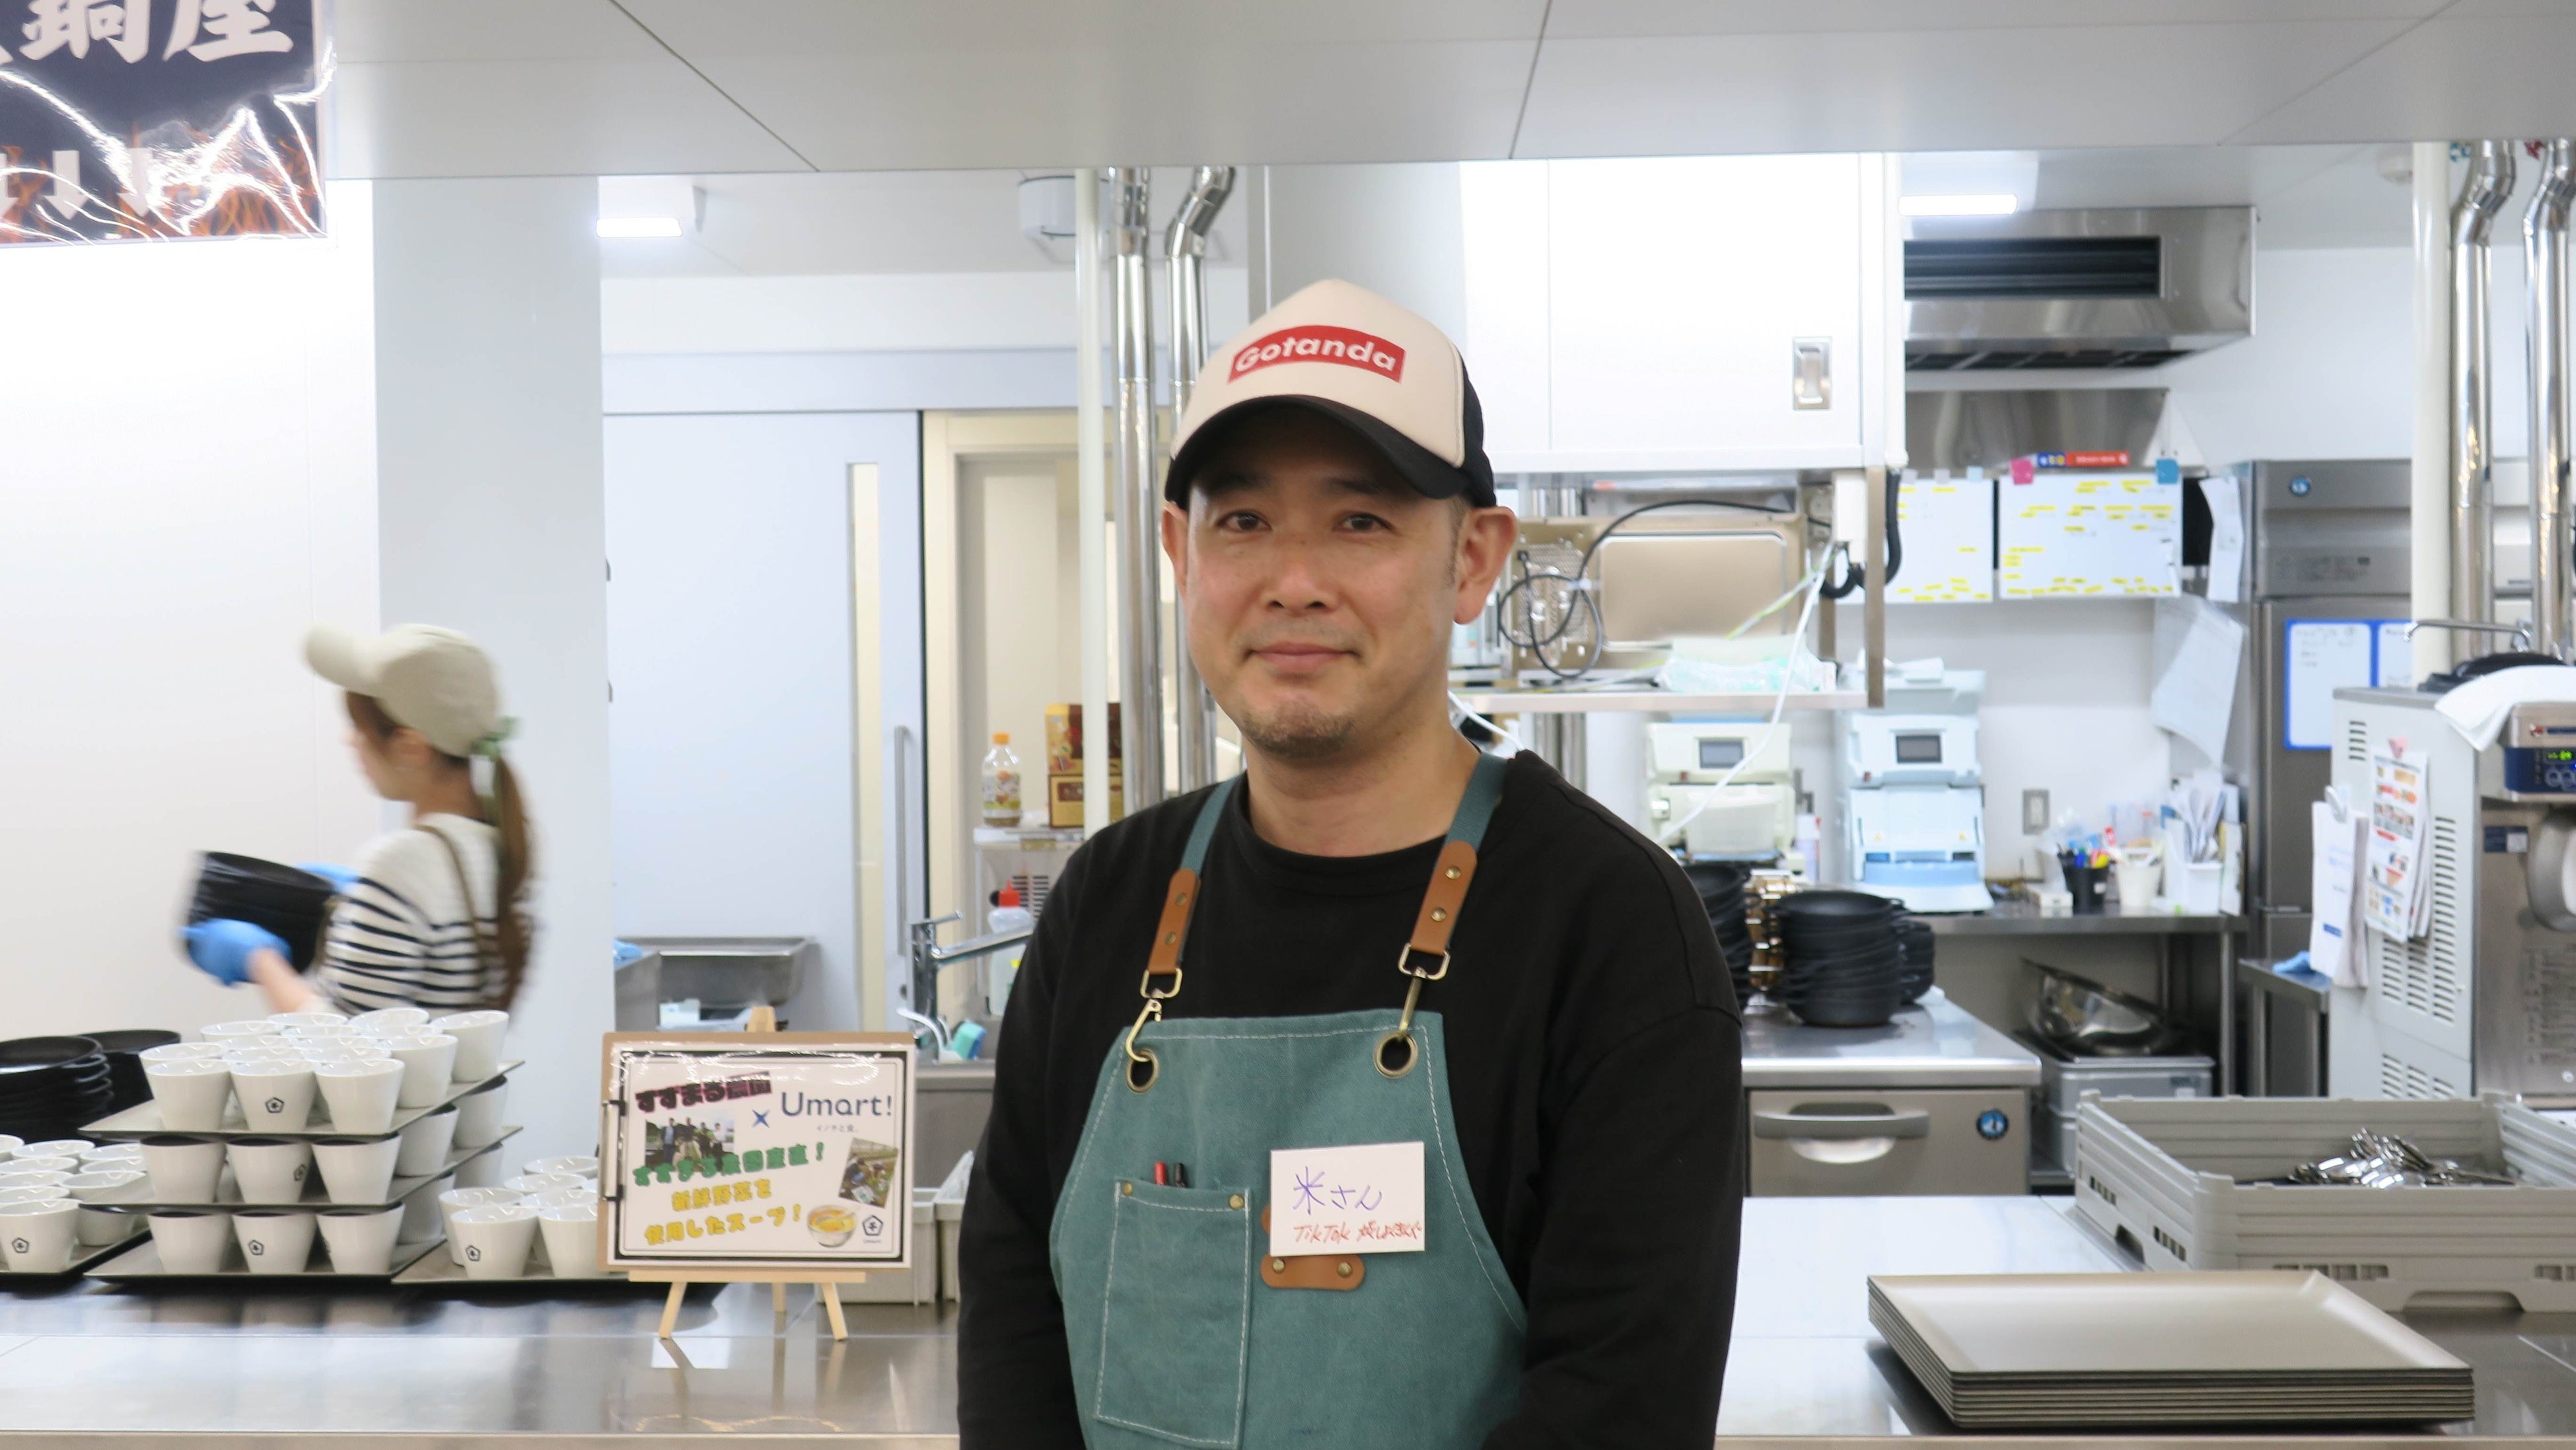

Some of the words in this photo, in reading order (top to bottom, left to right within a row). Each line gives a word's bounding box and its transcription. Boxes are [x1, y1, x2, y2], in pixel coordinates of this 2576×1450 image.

[1234, 336, 1397, 372] Gotanda
[781, 1091, 892, 1117] Umart!
[1293, 1166, 1382, 1215] 米さん
